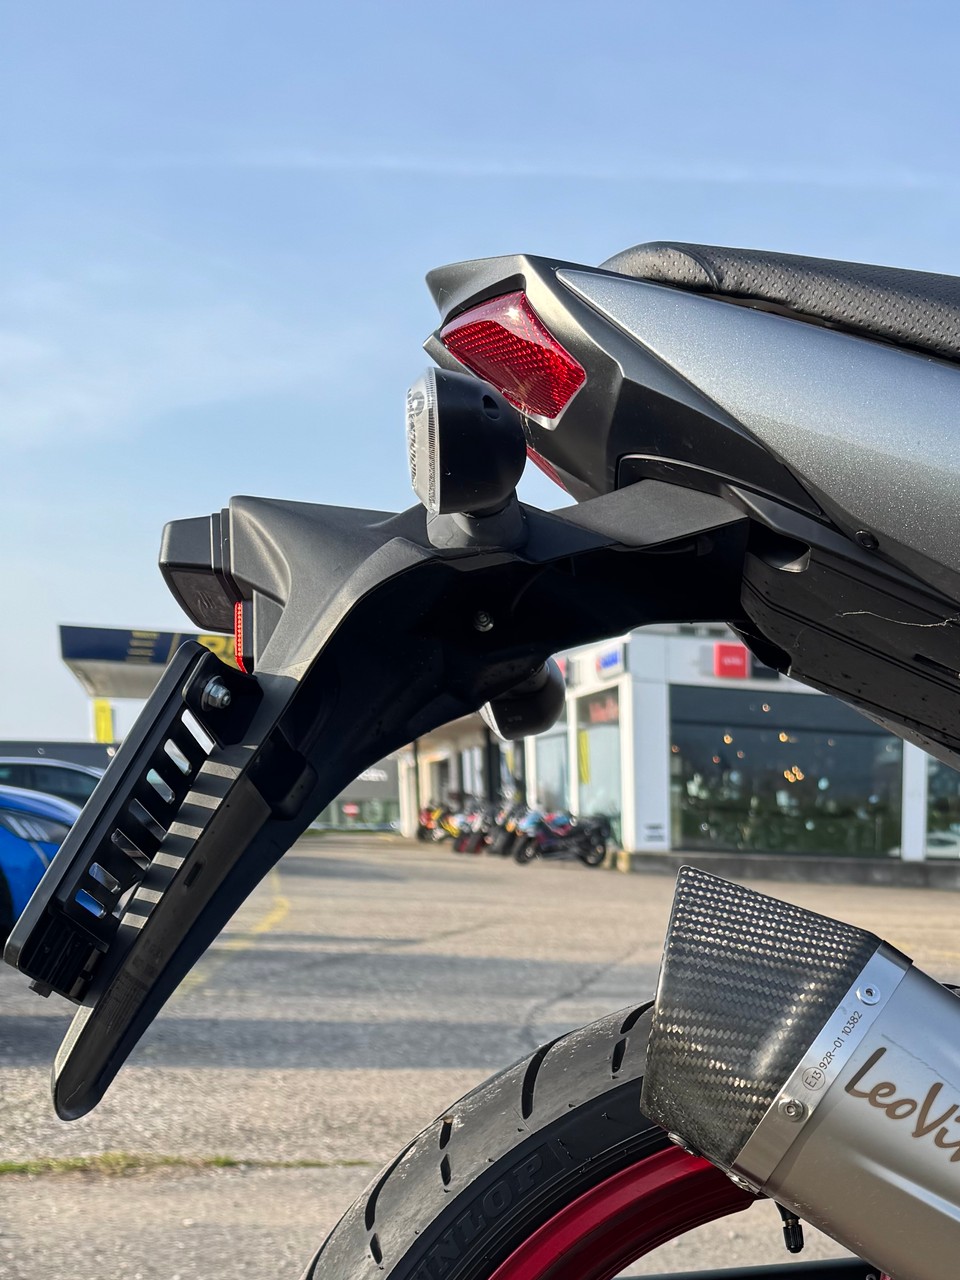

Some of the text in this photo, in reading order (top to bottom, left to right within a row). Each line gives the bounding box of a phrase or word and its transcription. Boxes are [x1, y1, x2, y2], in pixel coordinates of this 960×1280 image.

[804, 1010, 863, 1088] E13 92R-01 10382
